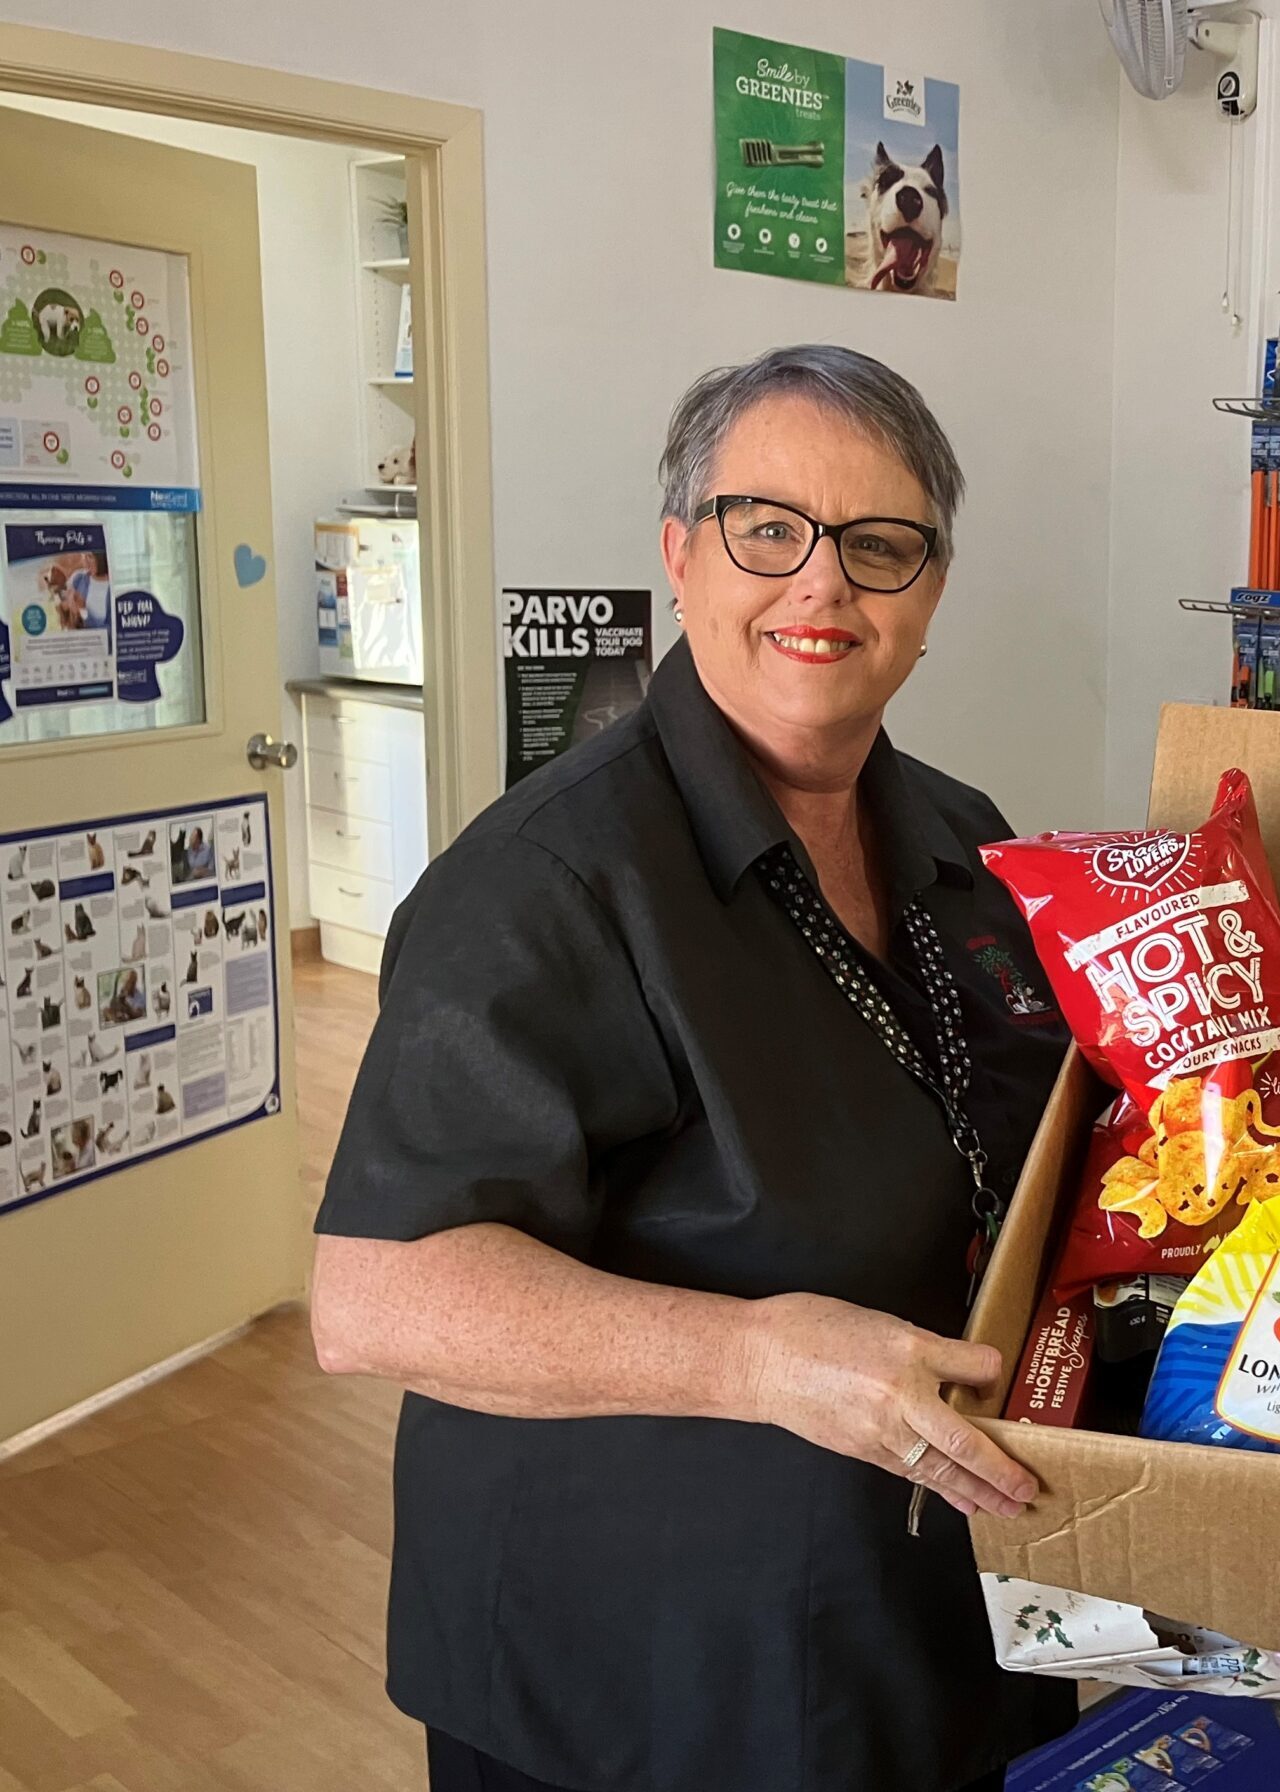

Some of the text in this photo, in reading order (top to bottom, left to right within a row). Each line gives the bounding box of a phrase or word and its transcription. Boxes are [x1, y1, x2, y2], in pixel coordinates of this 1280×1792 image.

[757, 58, 810, 88] Smile by
[736, 76, 823, 110] GREENIES
[886, 96, 922, 115] Greenies
[795, 108, 821, 121] treats
[726, 182, 838, 211] Give them the tasty treat that
[744, 202, 818, 224] freshens and cleans
[503, 592, 614, 626] PARVO
[1236, 592, 1271, 604] rogz
[504, 625, 590, 658] KILLS
[594, 627, 643, 637] VACCINATE
[595, 637, 643, 647] YOUR DOG
[595, 647, 625, 657] TODAY
[1106, 834, 1170, 872] Snack
[1144, 866, 1159, 878] SINCE
[1116, 893, 1200, 939] FLAVOURED
[1085, 909, 1264, 1013] HOT &
[1122, 957, 1264, 1047] SPICY
[1144, 1006, 1271, 1069] COCKTAIL MIX
[1183, 1037, 1262, 1069] OURY SNACKS
[1161, 1244, 1201, 1259] PROUDLY
[1025, 1326, 1051, 1384] TRADITIONAL
[1030, 1307, 1071, 1409] SHORTBREAD
[1051, 1313, 1089, 1409] FESTIVE Shapes
